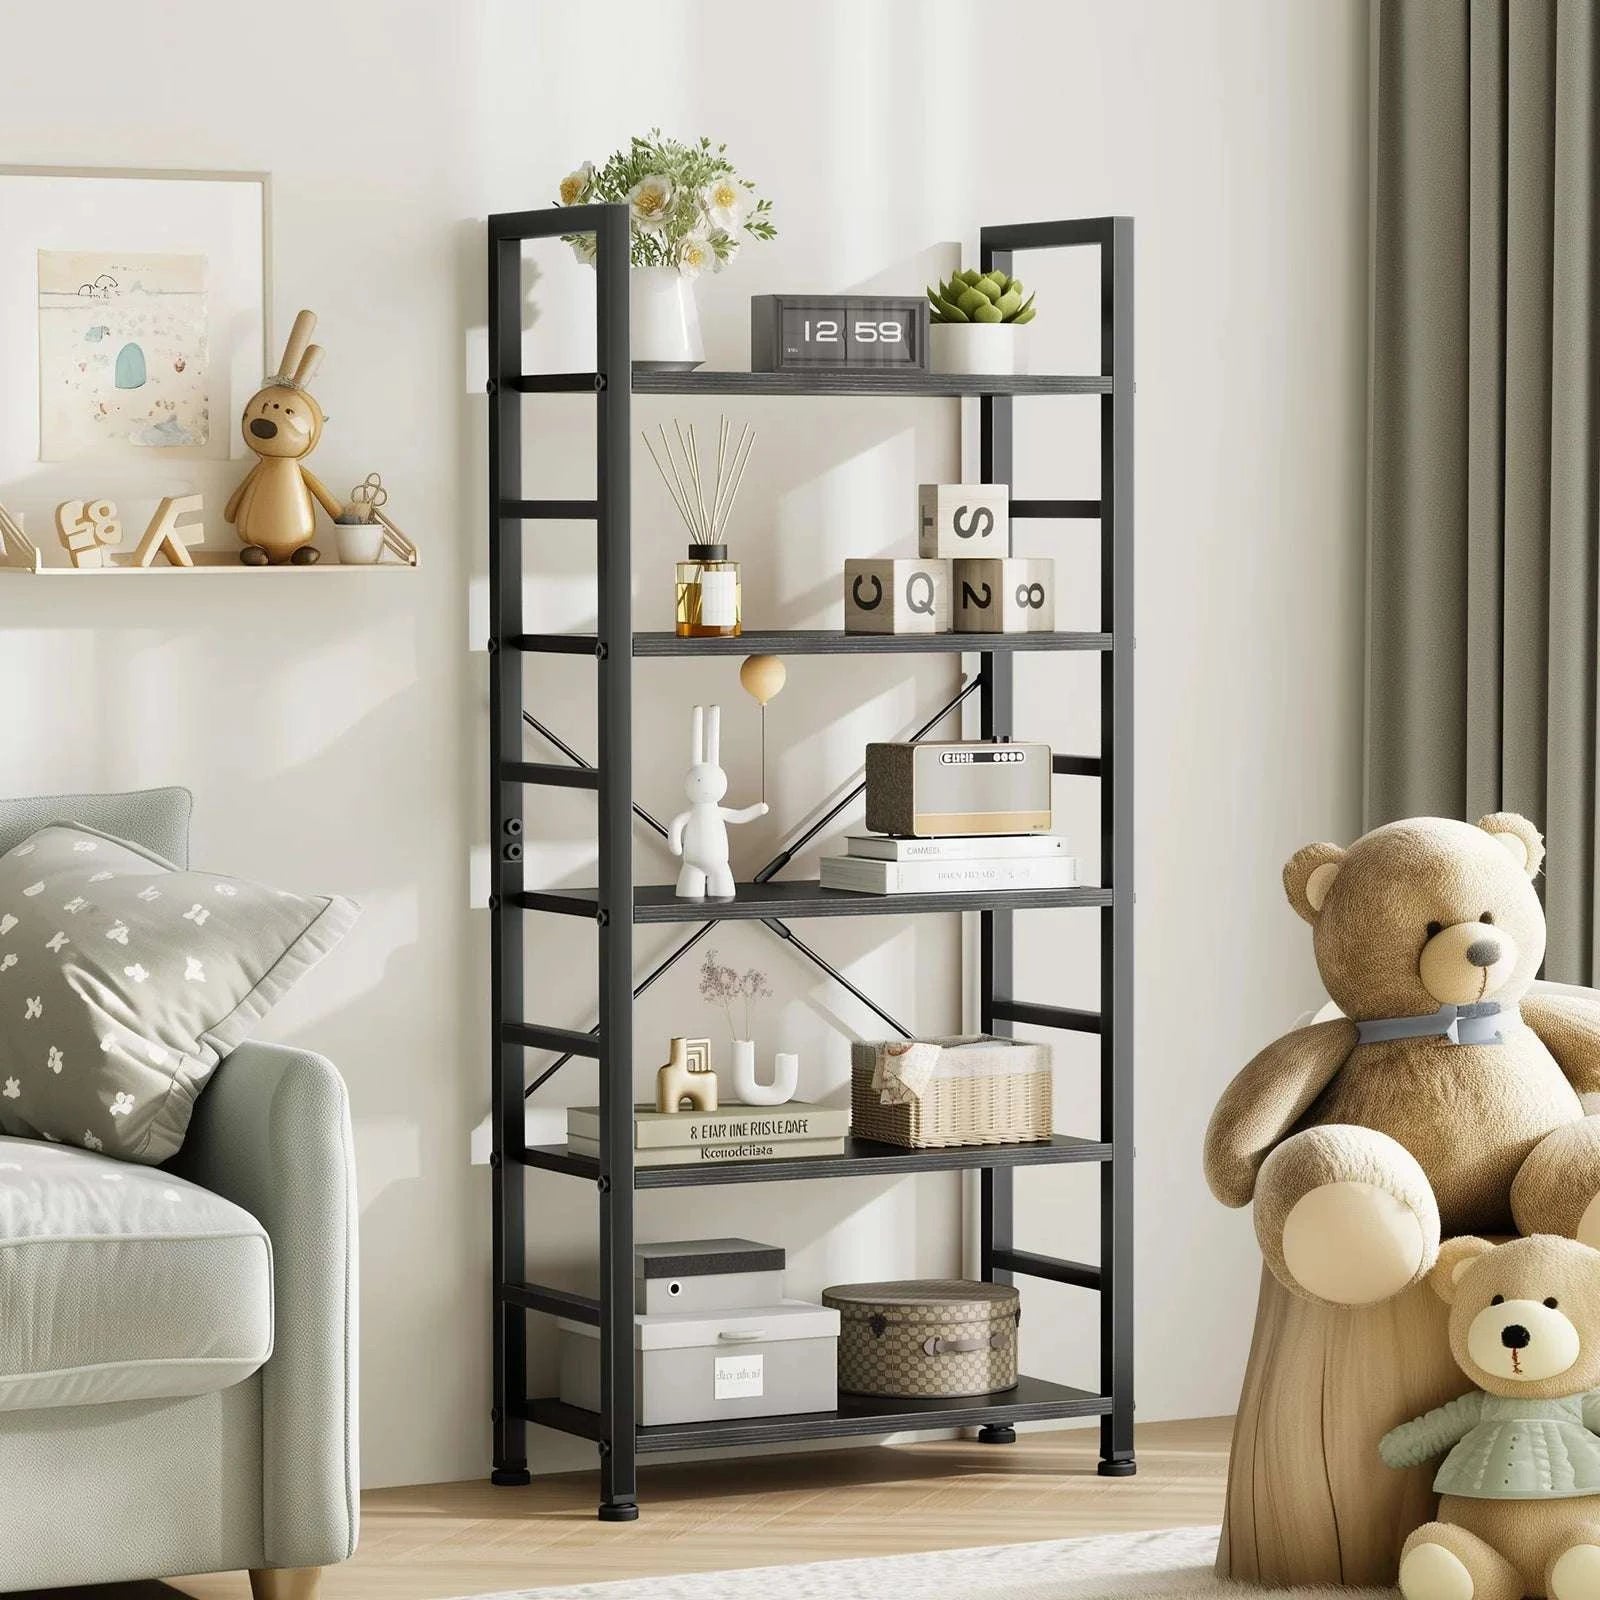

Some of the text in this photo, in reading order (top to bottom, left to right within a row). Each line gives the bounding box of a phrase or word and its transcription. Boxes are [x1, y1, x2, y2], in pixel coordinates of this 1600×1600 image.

[804, 320, 902, 343] 12 59
[953, 505, 994, 539] S
[852, 574, 883, 611] C
[906, 571, 935, 616] Q
[962, 581, 992, 610] 2
[1015, 582, 1045, 610] 8
